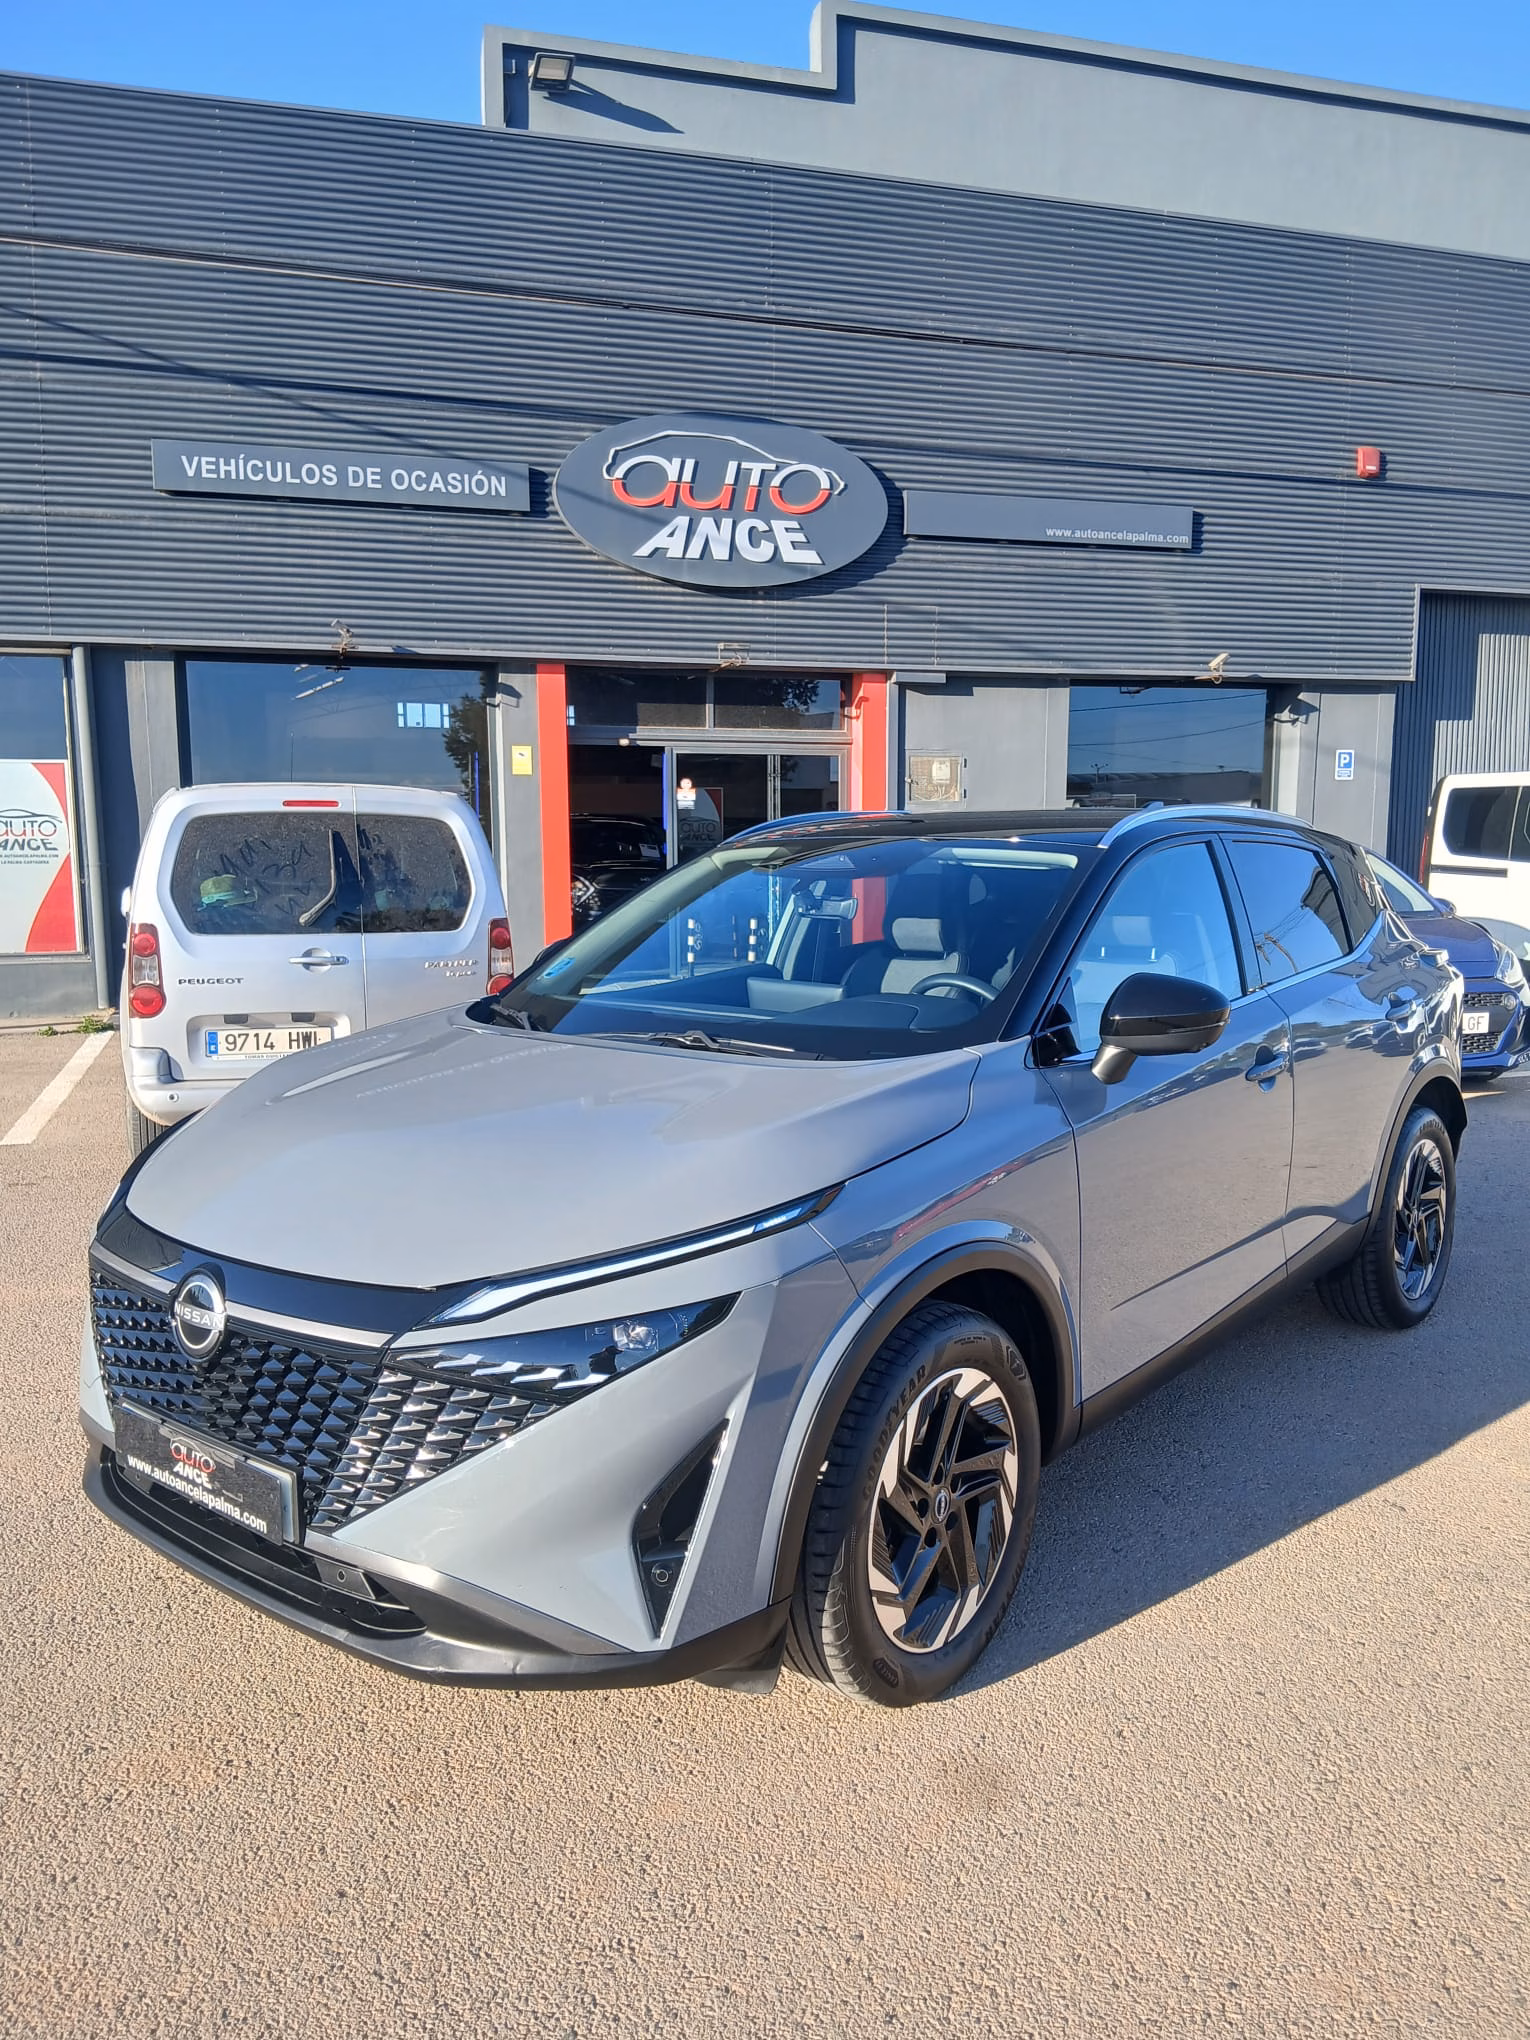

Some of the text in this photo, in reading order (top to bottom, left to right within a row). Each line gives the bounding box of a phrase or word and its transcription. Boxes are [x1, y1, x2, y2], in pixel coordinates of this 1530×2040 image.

[180, 454, 507, 496] VEHÍCULOS DE OCASIÓN
[632, 516, 825, 565] ANCE
[1045, 527, 1190, 544] www.autoancelapalma.com
[1340, 754, 1350, 767] P
[178, 977, 245, 985] PEUGEOT
[1462, 1015, 1486, 1032] GF
[224, 1032, 276, 1051] 9714
[174, 1300, 225, 1329] NISSAN
[172, 1461, 213, 1490] ANCE
[126, 1454, 268, 1535] www.autoancelapalma.com
